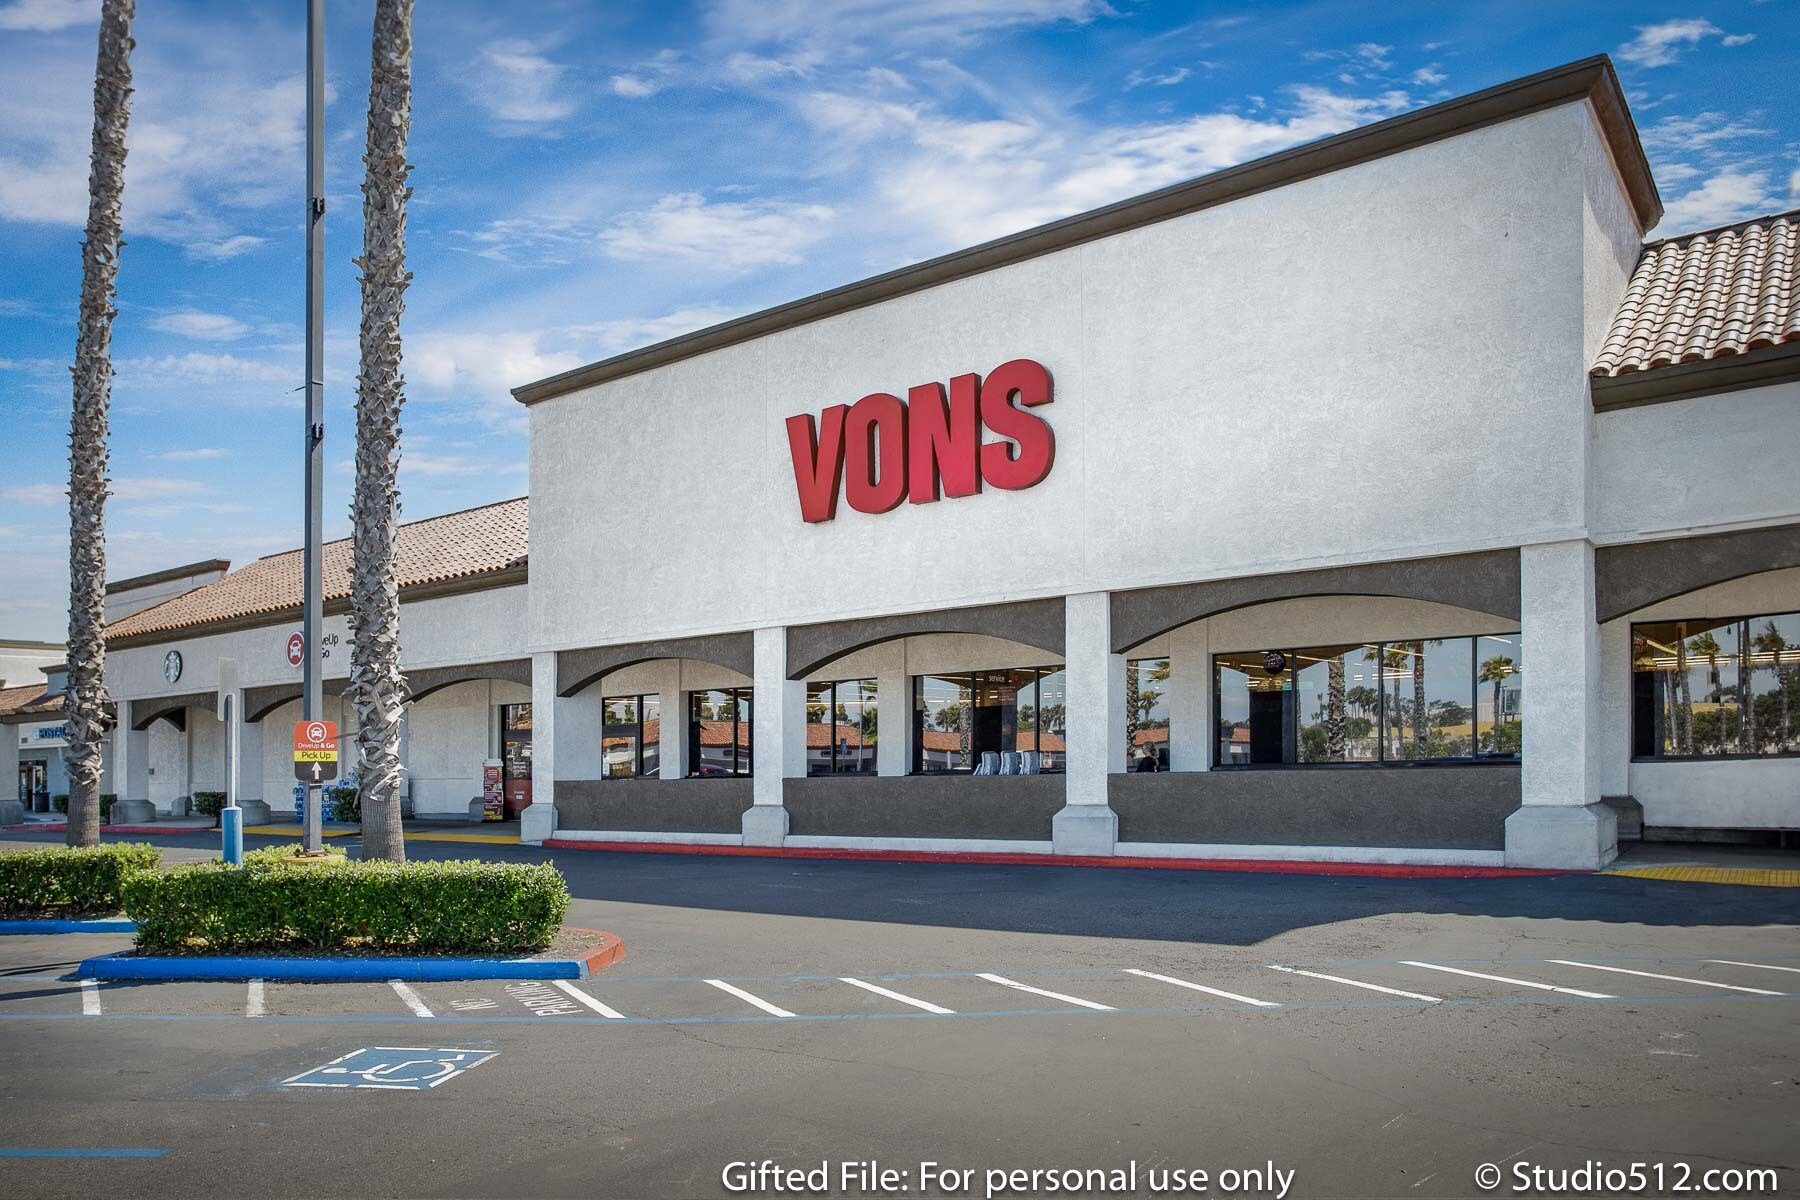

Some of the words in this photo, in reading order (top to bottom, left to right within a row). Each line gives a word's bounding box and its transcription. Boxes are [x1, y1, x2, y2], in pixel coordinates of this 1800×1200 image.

[785, 359, 1056, 524] VONS
[301, 751, 318, 759] Pick
[319, 751, 331, 760] Up
[503, 982, 585, 1017] PARKING
